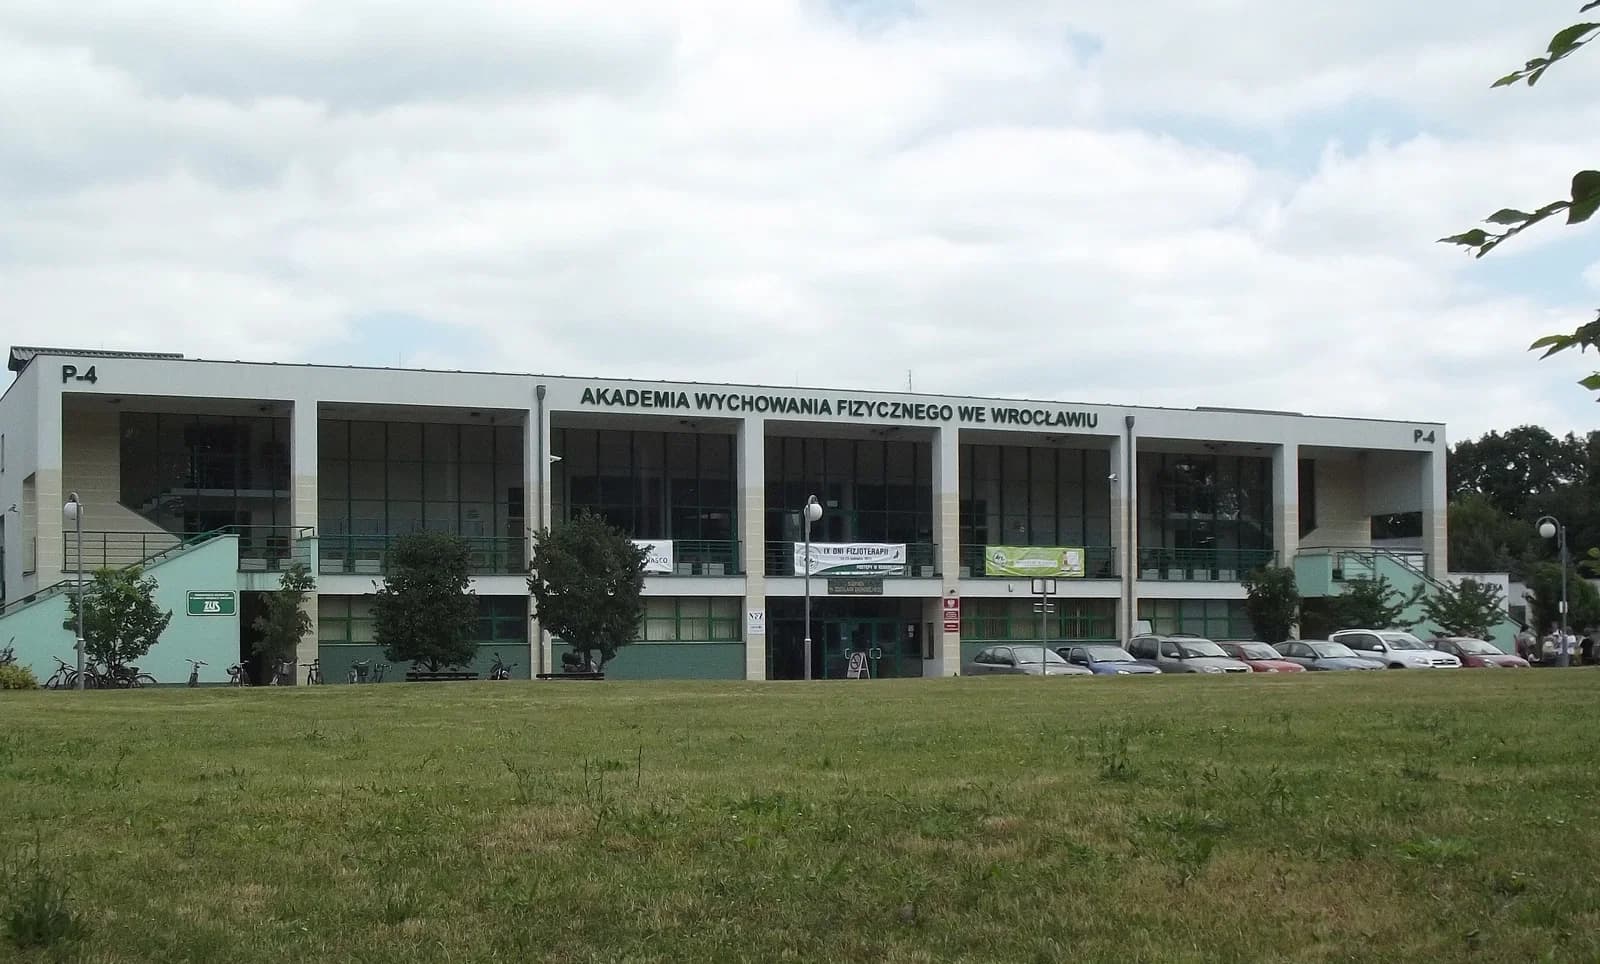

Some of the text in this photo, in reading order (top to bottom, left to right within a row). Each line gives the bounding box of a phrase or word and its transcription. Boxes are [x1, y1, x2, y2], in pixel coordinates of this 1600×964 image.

[62, 365, 98, 385] P-4
[581, 387, 1099, 428] AKADEMIA WYCHOWANIA FIZYCZNEGO WE WROCŁAWIU
[1414, 429, 1435, 444] P-4
[832, 547, 844, 555] DNI
